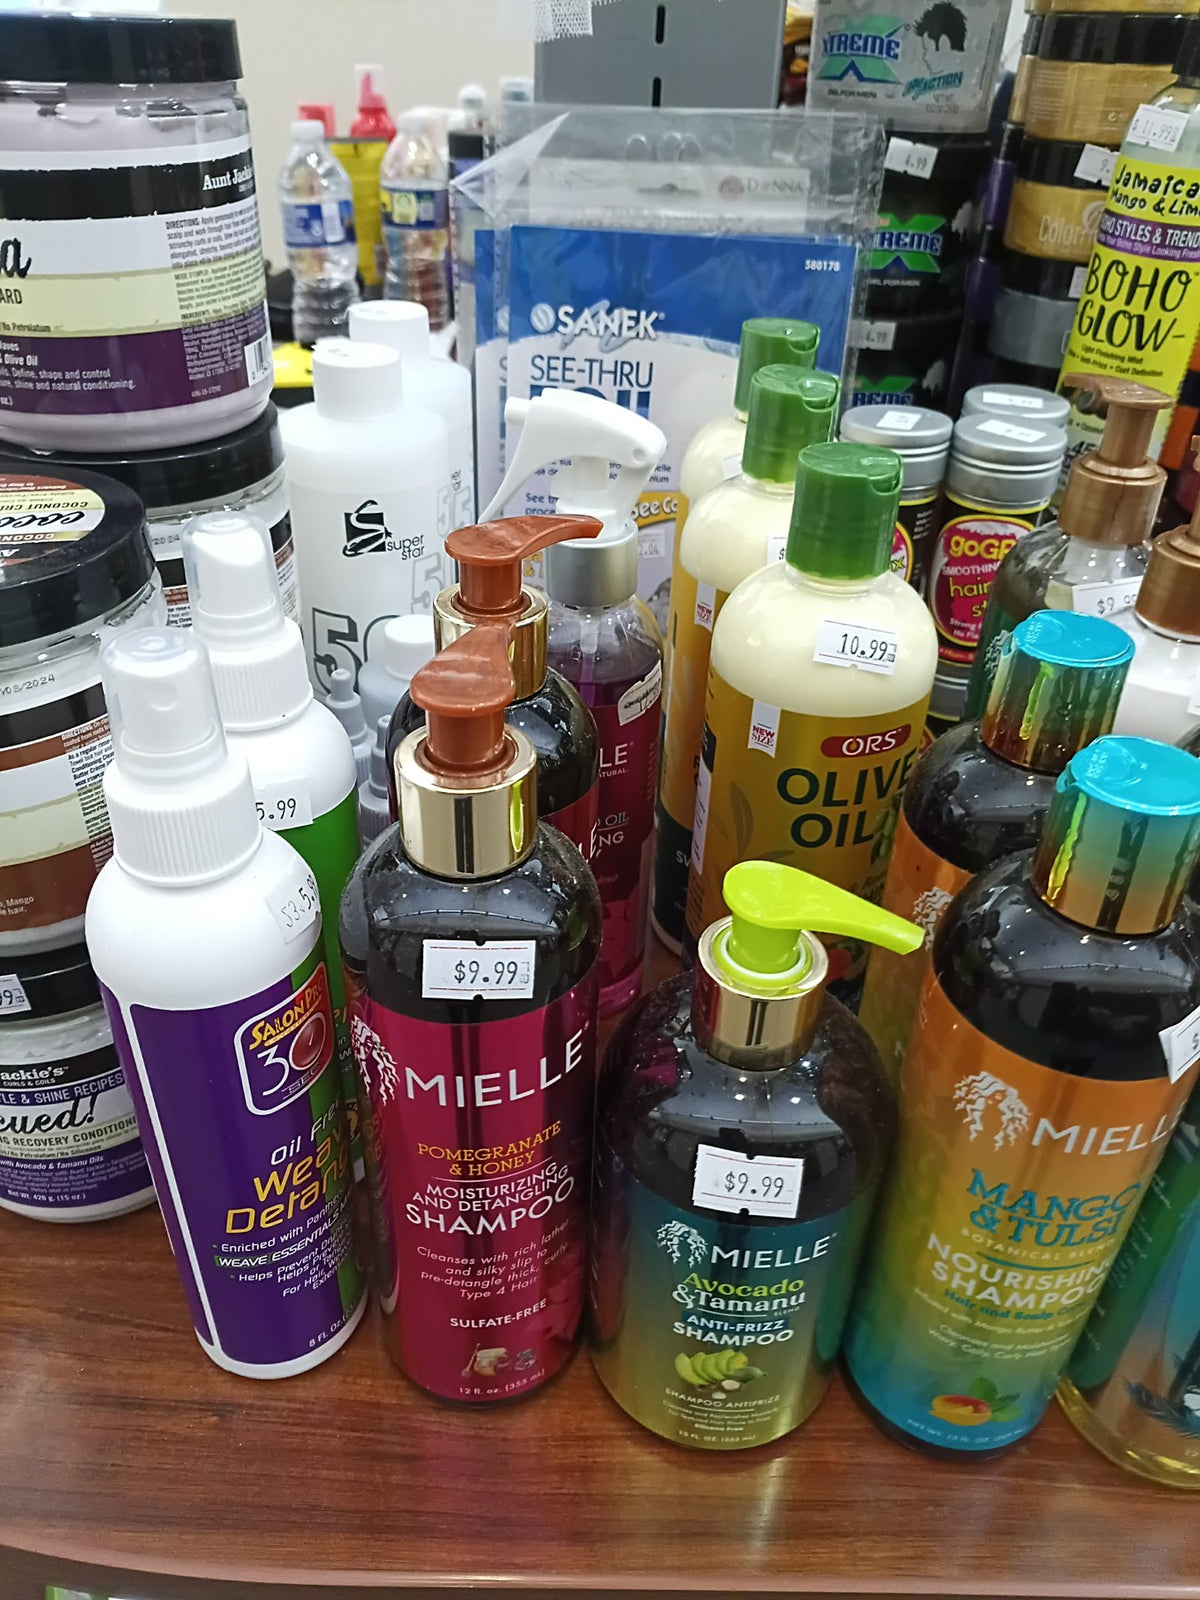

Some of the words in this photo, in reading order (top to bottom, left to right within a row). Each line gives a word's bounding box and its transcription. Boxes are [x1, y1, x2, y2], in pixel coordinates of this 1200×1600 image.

[202, 171, 232, 191] Aunt
[1153, 197, 1165, 217] &
[1115, 219, 1152, 242] STYLES
[1152, 228, 1162, 244] &
[1152, 246, 1181, 259] Looking
[804, 260, 840, 273] 580178
[1085, 252, 1192, 313] BOHO
[557, 305, 659, 340] SANEK
[4, 353, 25, 366] Olive
[26, 355, 38, 366] Oil
[531, 354, 653, 389] SEE-THRU
[36, 381, 50, 391] and
[52, 381, 81, 391] natural
[39, 369, 63, 380] shape
[65, 369, 80, 379] and
[82, 368, 111, 379] control
[27, 501, 88, 511] COCONUT
[525, 493, 546, 504] See
[387, 534, 424, 552] super
[401, 546, 425, 561] star
[949, 576, 991, 598] hair
[697, 602, 712, 615] NEW
[836, 632, 889, 662] 10.99
[751, 732, 774, 747] SIZE
[752, 724, 776, 740] NEW
[842, 729, 899, 756] ORS
[80, 745, 97, 756] regular
[71, 758, 102, 773] Conditioning
[73, 771, 88, 781] Butter
[777, 747, 918, 808] OLIVE
[255, 798, 296, 821] 5.99
[791, 811, 875, 849] OIL
[7, 906, 28, 915] hair.
[454, 960, 518, 985] $9.99
[405, 1029, 582, 1108] MIELLE
[21, 1094, 30, 1104] &
[34, 1088, 70, 1104] SHINE
[74, 1073, 124, 1098] RECIPES
[35, 1078, 56, 1086] COILS
[12, 1135, 69, 1147] RECOVERY
[270, 1135, 302, 1166] Oil
[417, 1120, 561, 1161] POMEGRANATE
[15, 1161, 47, 1170] Avocado
[57, 1160, 87, 1169] Tamanu
[89, 1154, 104, 1165] Oils
[449, 1164, 462, 1176] &
[469, 1151, 536, 1176] HONEY
[413, 1192, 452, 1210] AND
[459, 1165, 569, 1212] DETANGLING
[427, 1162, 558, 1200] MOISTURIZING
[724, 1171, 785, 1198] $9.99
[406, 1176, 575, 1235] SHAMPOO
[967, 1168, 1142, 1222] MANGO
[970, 1203, 1000, 1234] &
[1008, 1209, 1126, 1248] TULSI
[219, 1255, 268, 1268] WEAVE
[271, 1208, 340, 1262] ESSENTIALS
[221, 1237, 276, 1253] Enriched
[280, 1225, 303, 1243] with
[417, 1246, 475, 1265] Cleanses
[481, 1251, 509, 1264] with
[514, 1242, 536, 1258] rich
[541, 1218, 569, 1245] lather
[962, 1227, 1061, 1261] BOTANICAL
[239, 1271, 273, 1282] Helps
[277, 1247, 319, 1276] Prevent
[446, 1266, 471, 1276] and
[476, 1265, 506, 1277] silky
[510, 1256, 532, 1271] slip
[537, 1248, 547, 1260] to
[711, 1236, 831, 1269] MIELLE
[277, 1264, 310, 1283] Helps
[309, 1264, 320, 1276] or
[421, 1271, 502, 1289] pre-detangle
[508, 1265, 539, 1282] thick,
[282, 1283, 301, 1297] For
[460, 1289, 491, 1300] Type
[496, 1286, 505, 1295] 4
[511, 1276, 538, 1292] Hair
[683, 1272, 806, 1297] Avocado
[931, 1261, 1107, 1310] SHAMPOO
[694, 1289, 807, 1312] Tamanu
[450, 1298, 548, 1328] SULFATE-FREE
[686, 1314, 785, 1332] ANTI-FRIZZ
[317, 1331, 329, 1342] Fl.
[672, 1321, 795, 1346] SHAMPOO
[459, 1387, 471, 1395] 12
[664, 1387, 722, 1407] SHAMPOO
[725, 1394, 780, 1408] ANTIFRIZZ
